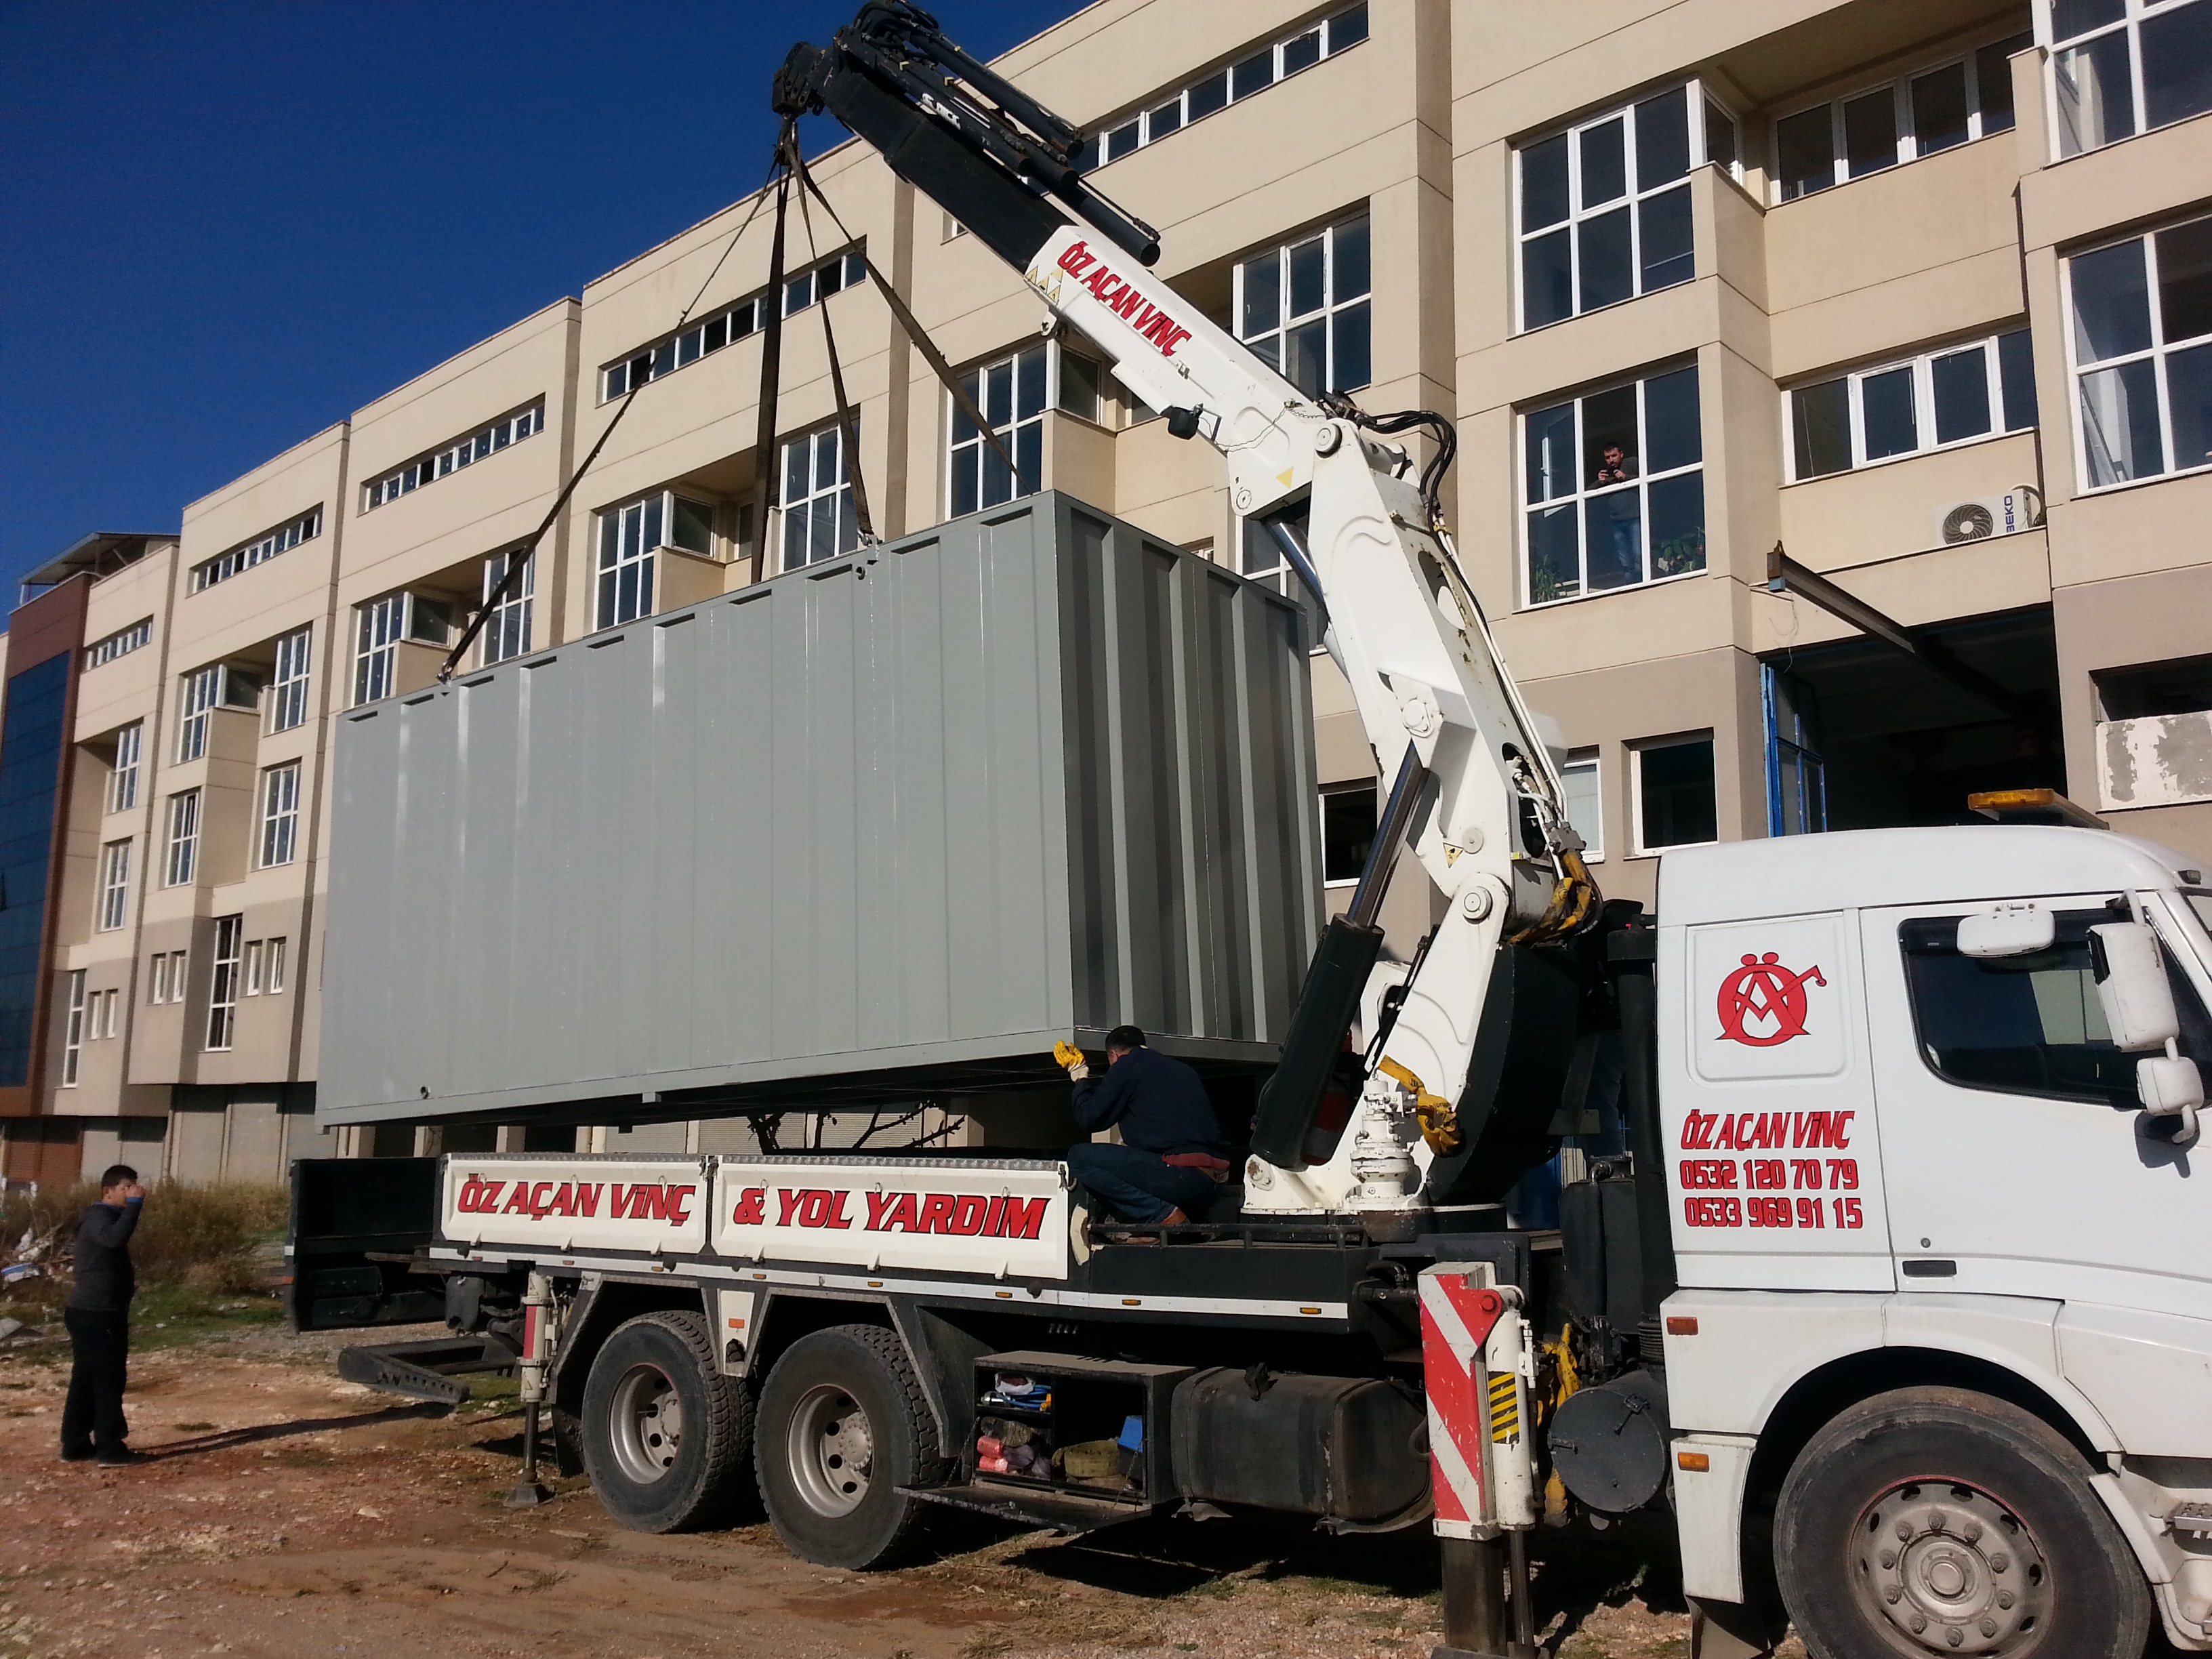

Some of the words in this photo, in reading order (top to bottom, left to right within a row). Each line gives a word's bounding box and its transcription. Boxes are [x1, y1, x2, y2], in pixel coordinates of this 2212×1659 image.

[1080, 265, 1147, 320] AÇAN
[2004, 495, 2015, 533] BEKO
[1681, 1109, 1719, 1149] ÖZ
[1713, 1112, 1792, 1151] AÇAN
[1680, 1159, 1738, 1189] 0532
[1743, 1159, 1786, 1189] 120
[1790, 1159, 1822, 1189] 70
[1826, 1159, 1859, 1189] 79
[458, 1173, 506, 1213] ÖZ
[500, 1182, 605, 1221] AÇAN
[733, 1188, 766, 1225] &
[775, 1189, 854, 1229] YOL
[863, 1191, 1052, 1240] YARDIM
[1685, 1197, 1742, 1227] 0533
[1748, 1197, 1793, 1227] 969
[1797, 1197, 1824, 1228] 91
[1833, 1197, 1863, 1229] 15
